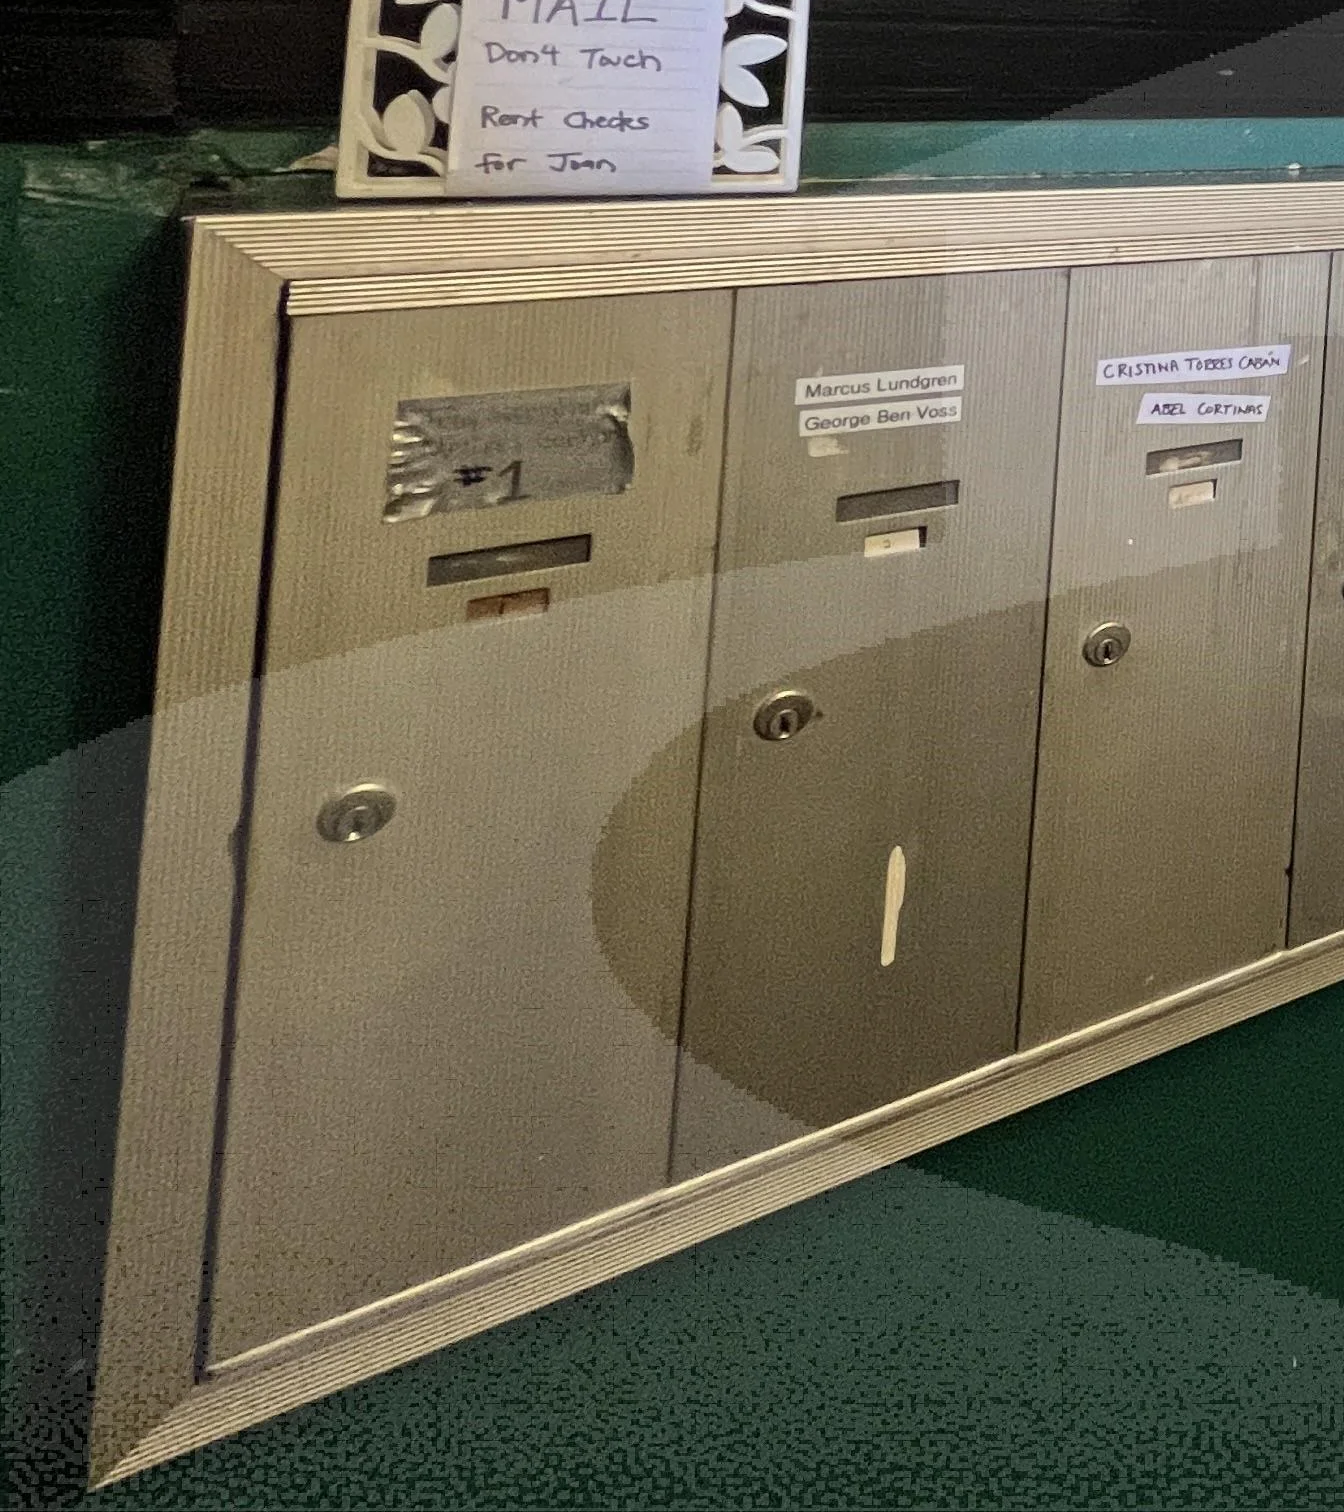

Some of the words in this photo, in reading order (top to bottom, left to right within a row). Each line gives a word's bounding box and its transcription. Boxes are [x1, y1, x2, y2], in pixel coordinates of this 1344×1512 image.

[481, 105, 544, 129] Rent
[563, 110, 651, 133] Checks
[475, 152, 528, 174] for
[1103, 359, 1180, 379] CRISTINA
[1184, 357, 1233, 371] TORRES
[805, 382, 871, 400] Marcus
[877, 374, 958, 394] Lundgren
[804, 414, 871, 431] George
[876, 408, 911, 425] Ben
[916, 404, 958, 420] Voss
[1150, 402, 1186, 417] ABEL
